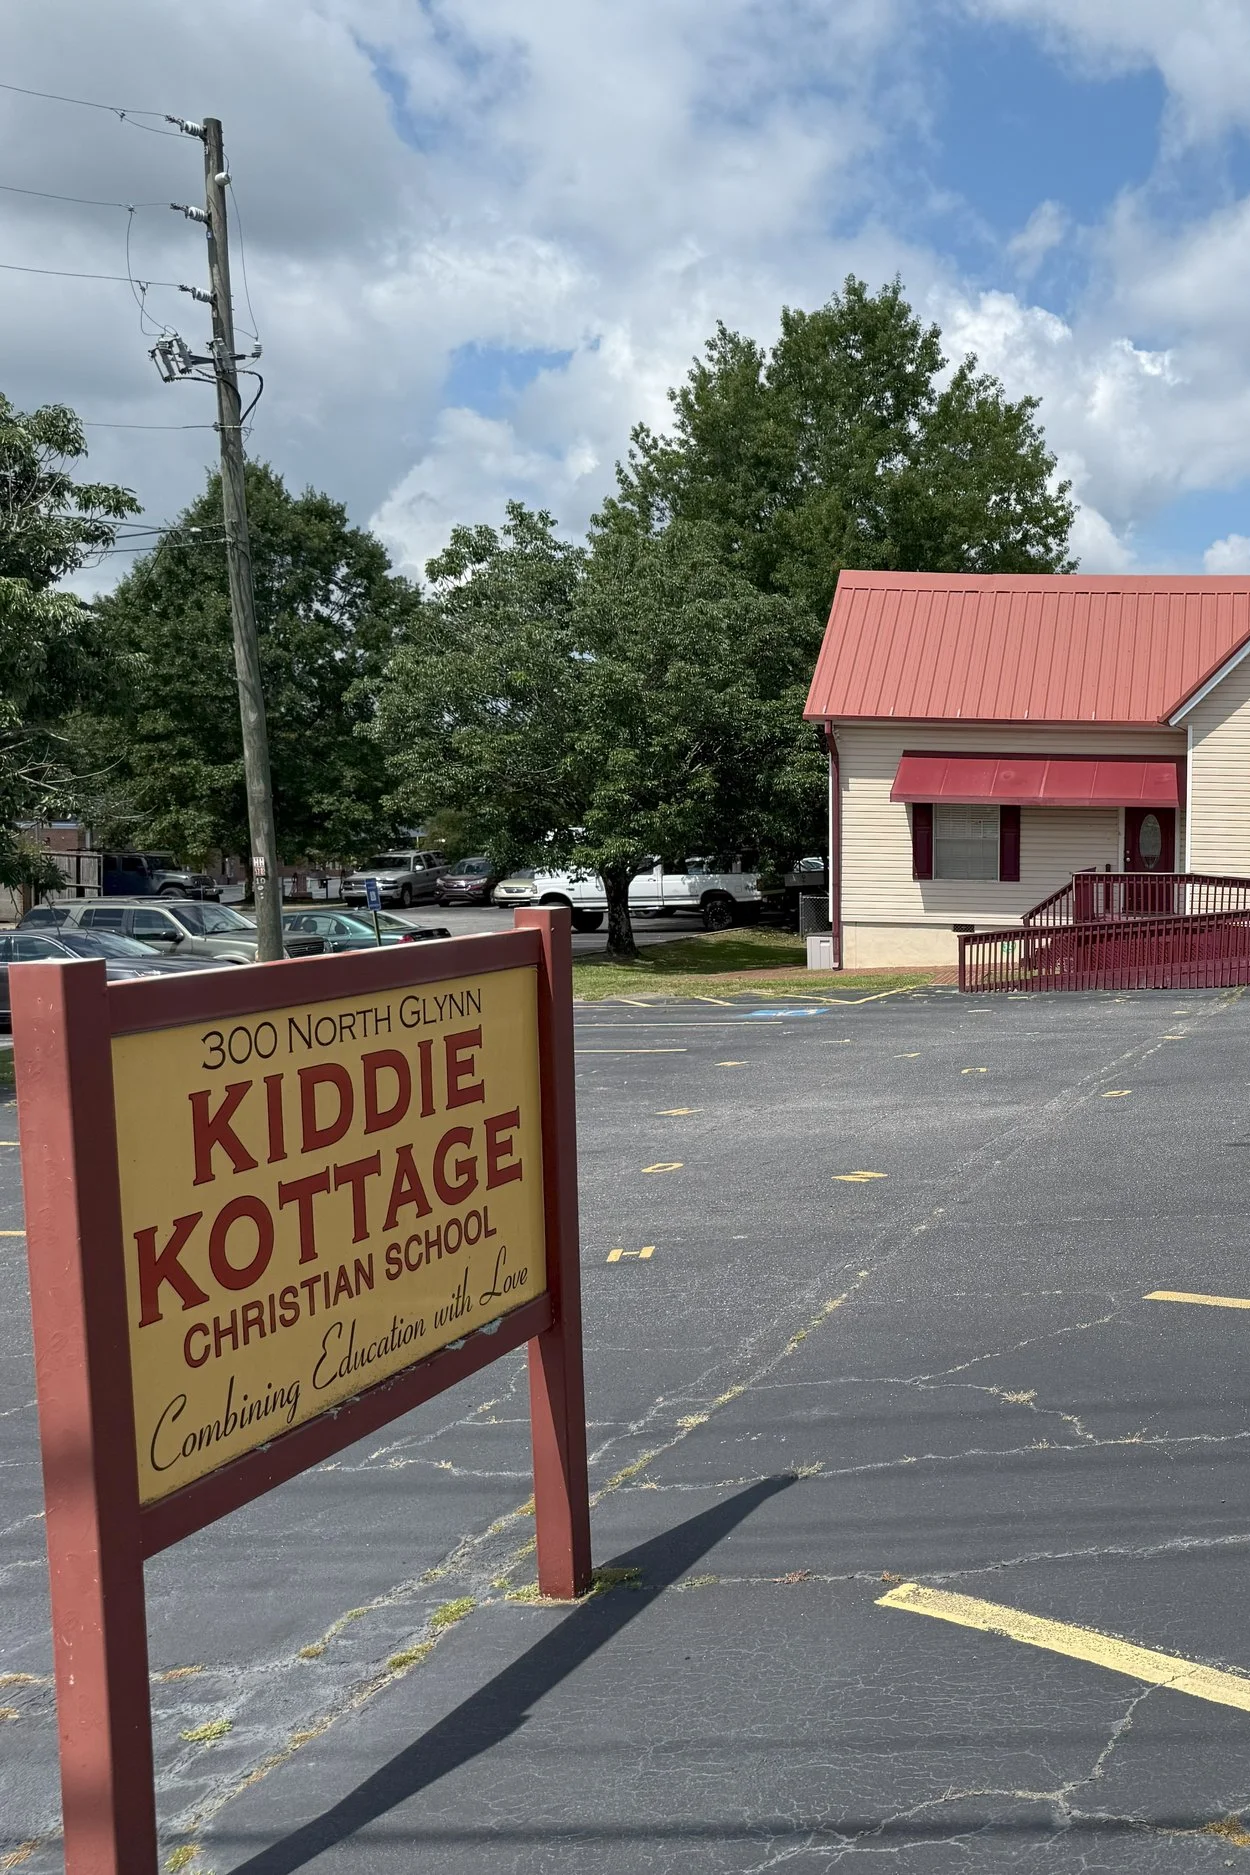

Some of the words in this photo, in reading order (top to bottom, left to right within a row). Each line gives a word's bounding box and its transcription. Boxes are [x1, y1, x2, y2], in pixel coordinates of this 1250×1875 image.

[188, 1023, 486, 1187] KIDDIE
[200, 1021, 278, 1071] 300
[287, 1004, 392, 1054] NORTH
[399, 987, 482, 1030] GLYNN
[133, 1105, 524, 1329] KOTTAGE
[183, 1252, 375, 1369] CHRISTIAN
[384, 1205, 497, 1282] SCHOOL
[150, 1375, 301, 1472] Combining
[312, 1314, 427, 1391] Education
[433, 1265, 474, 1330] with
[478, 1244, 528, 1308] Love
